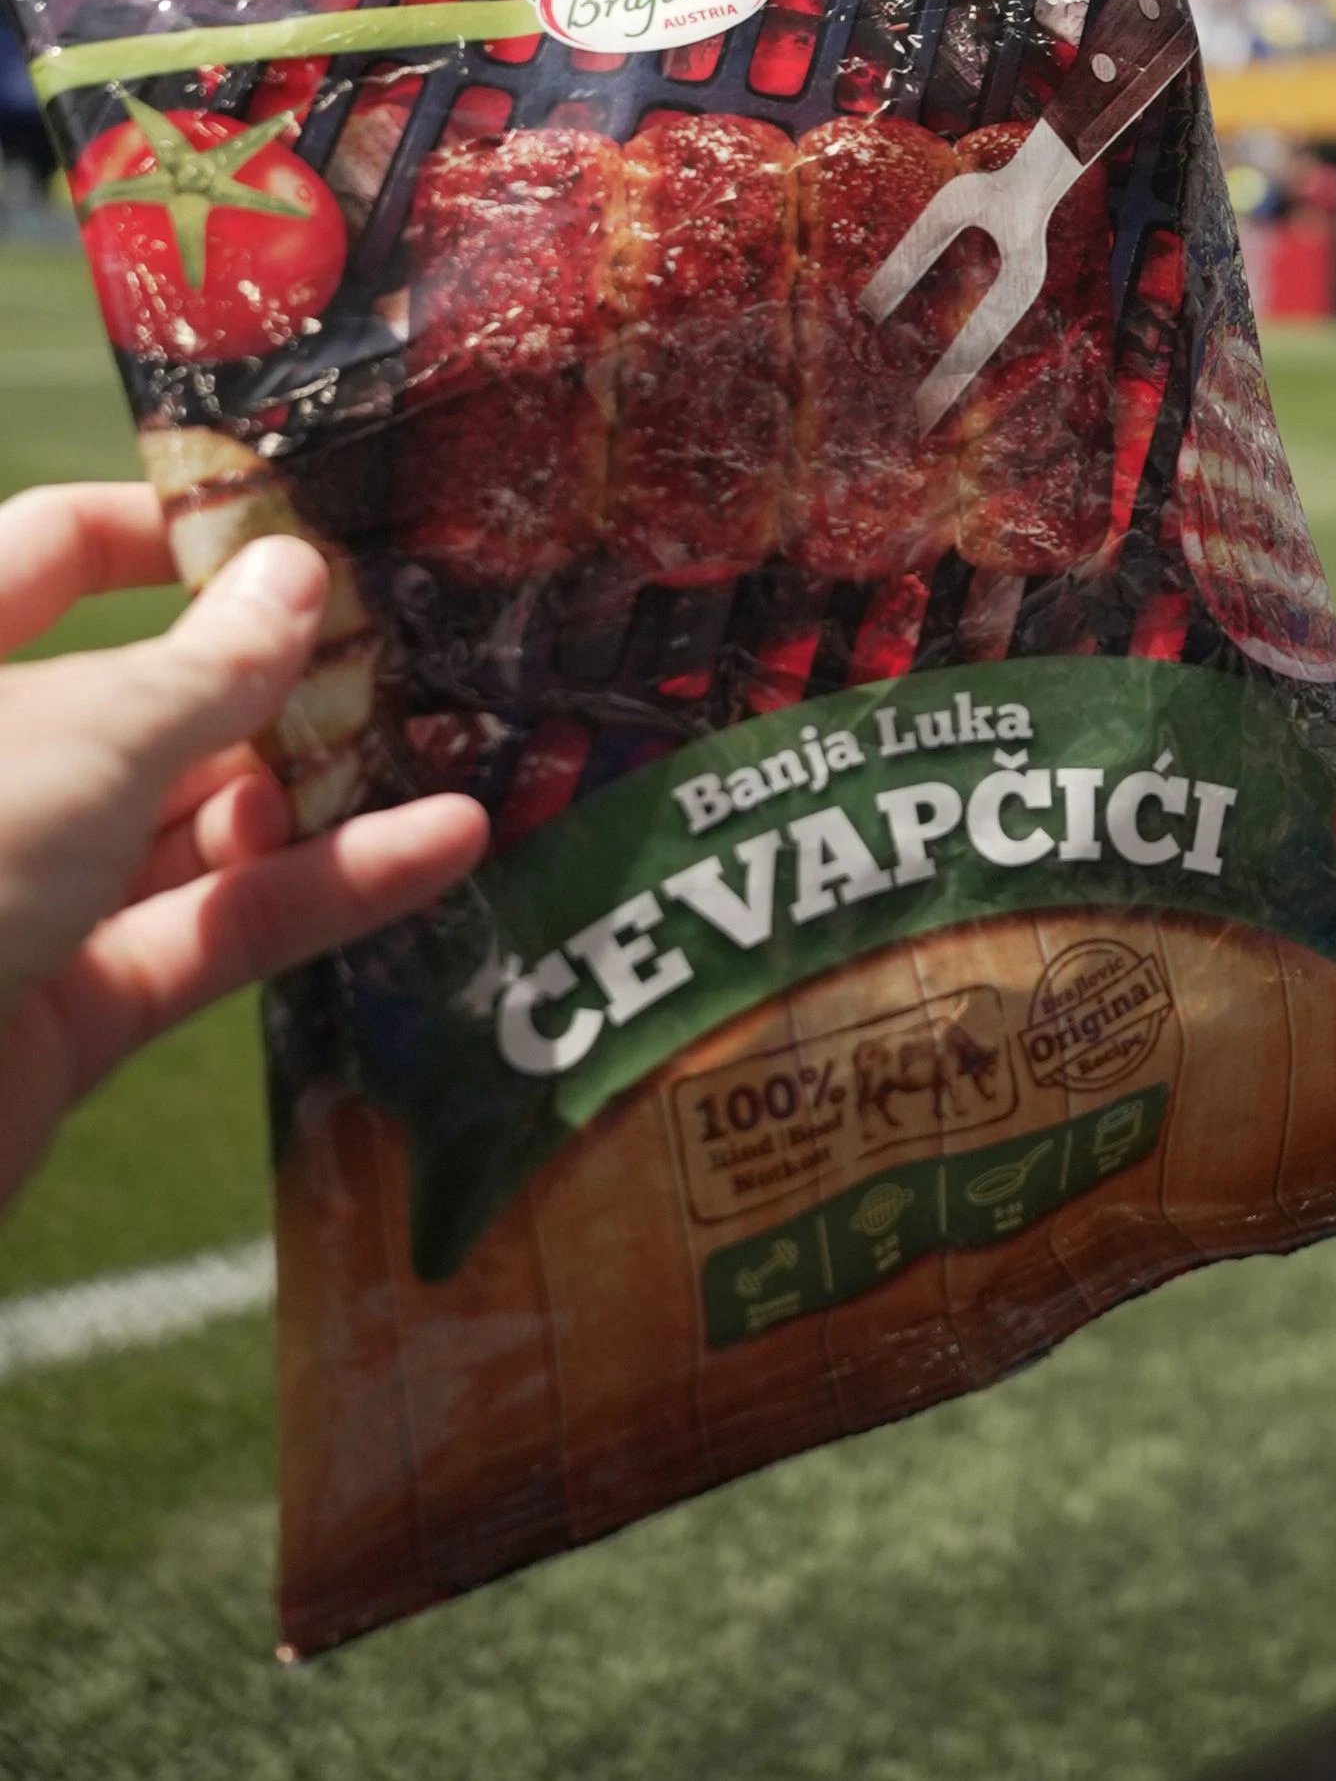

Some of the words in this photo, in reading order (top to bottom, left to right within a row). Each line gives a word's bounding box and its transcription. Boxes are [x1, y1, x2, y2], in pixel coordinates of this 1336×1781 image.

[663, 3, 738, 30] AUSTRIA
[672, 726, 866, 835] Banja
[877, 691, 1034, 758] Luka
[1028, 968, 1161, 1065] Original
[694, 1058, 848, 1143] 100%
